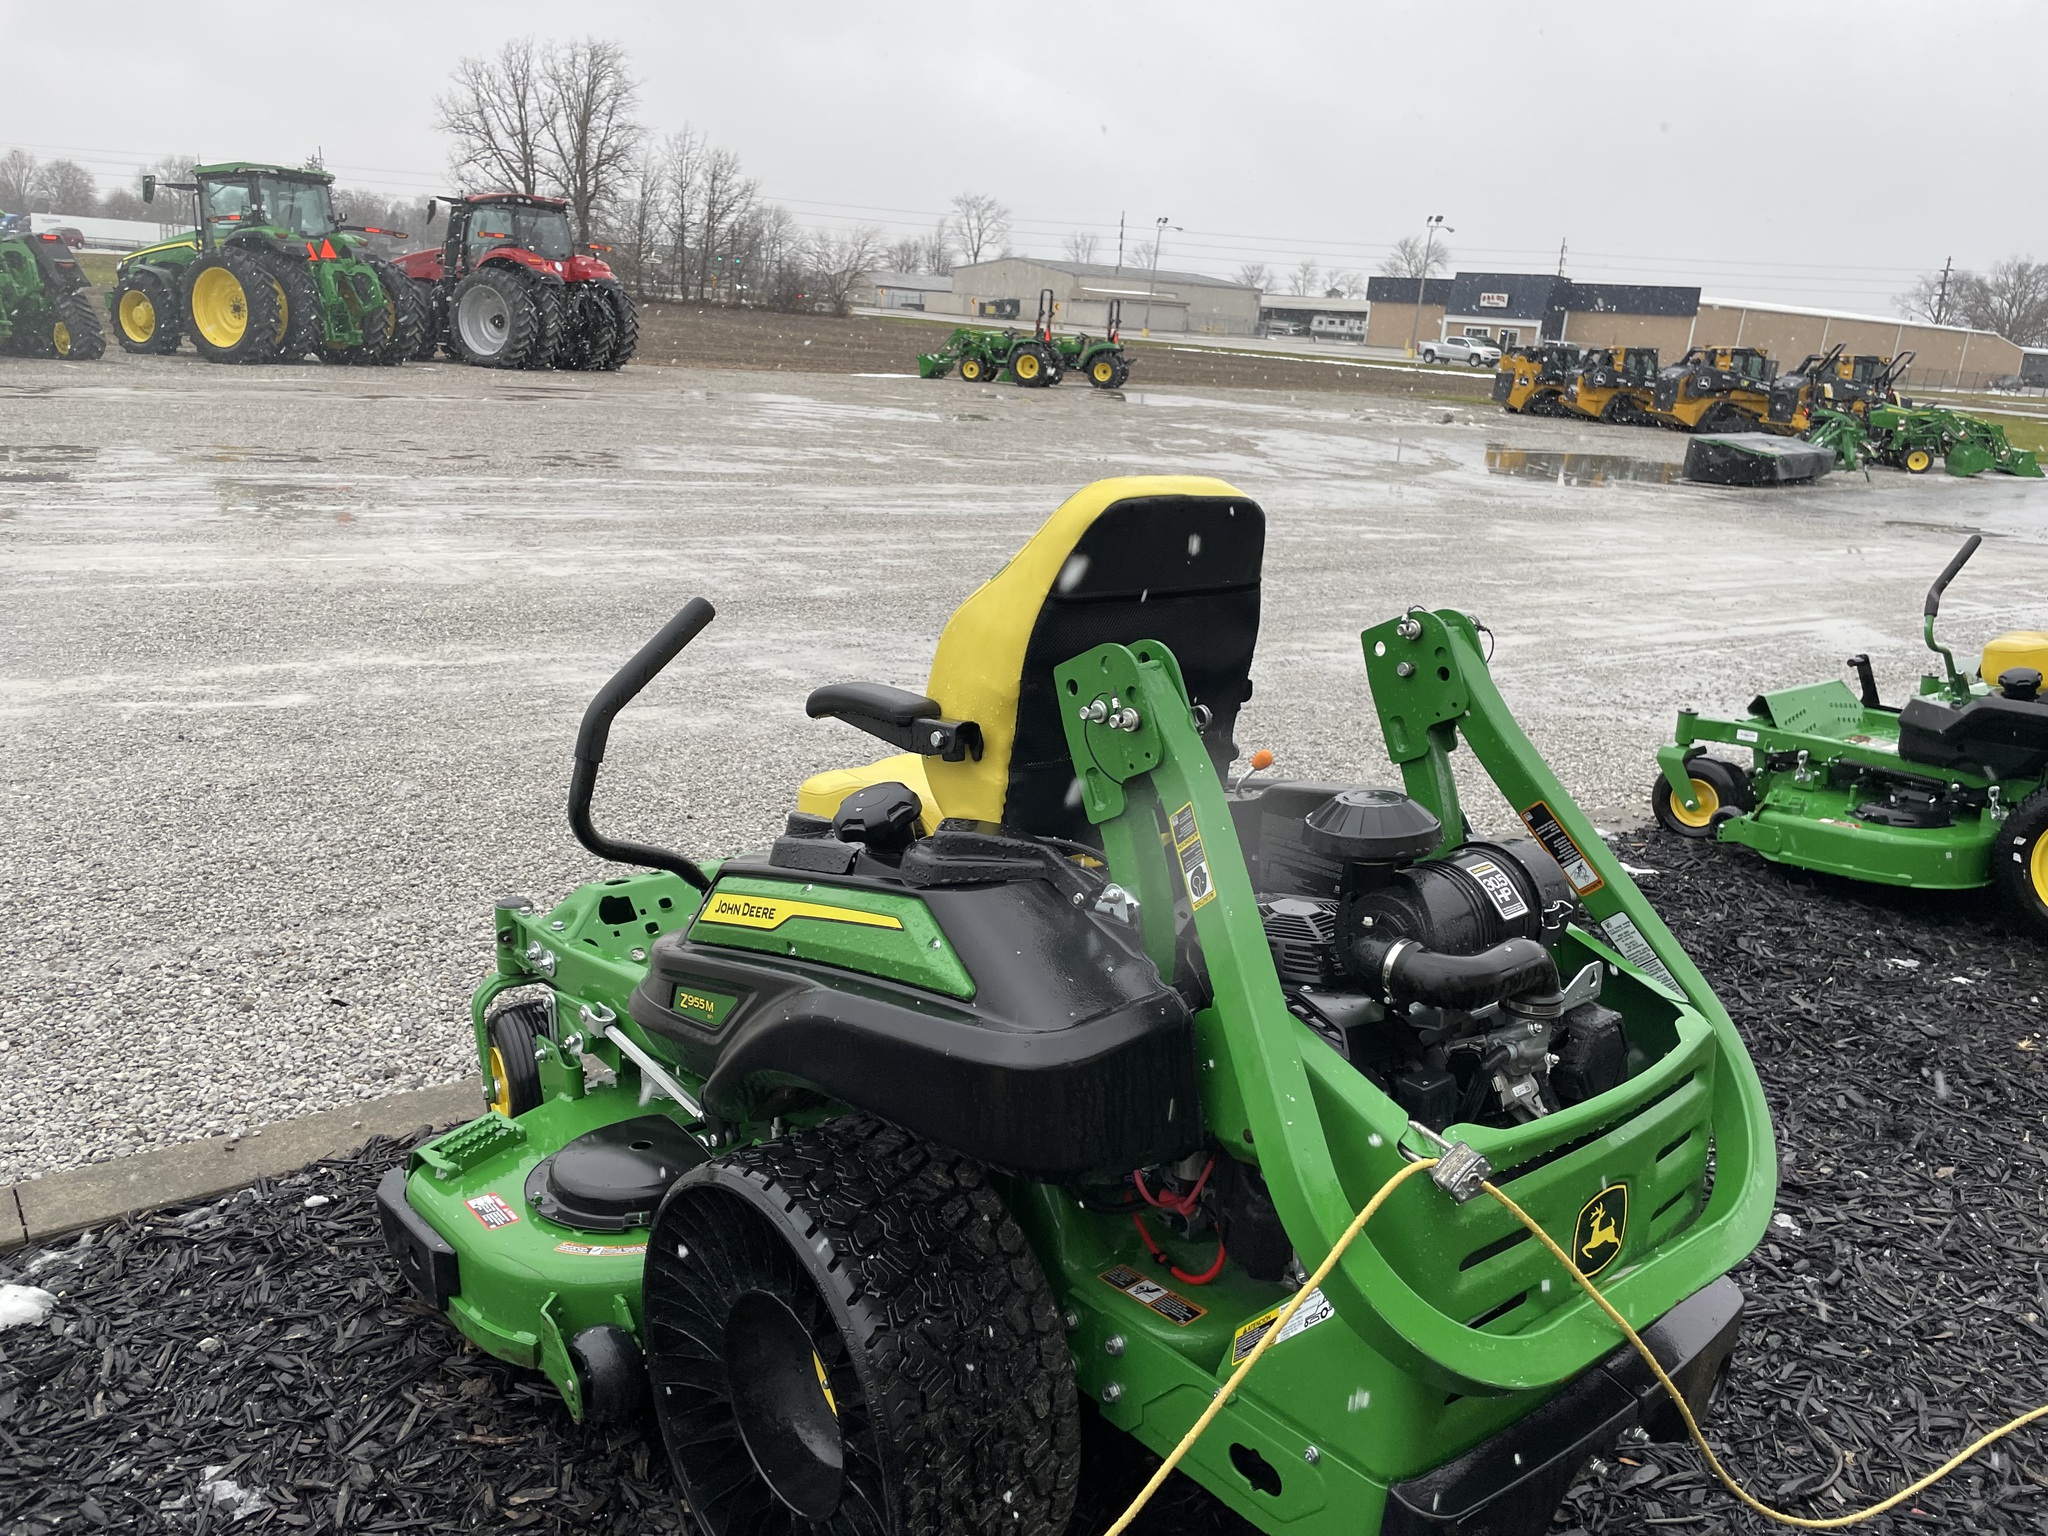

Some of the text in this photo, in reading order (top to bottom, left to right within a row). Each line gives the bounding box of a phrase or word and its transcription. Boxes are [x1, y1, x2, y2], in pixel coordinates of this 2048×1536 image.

[1494, 887, 1512, 903] HP
[715, 900, 776, 919] JOHN DEERE
[680, 993, 714, 1013] Z955M
[1247, 1313, 1272, 1331] ATENCIÓN
